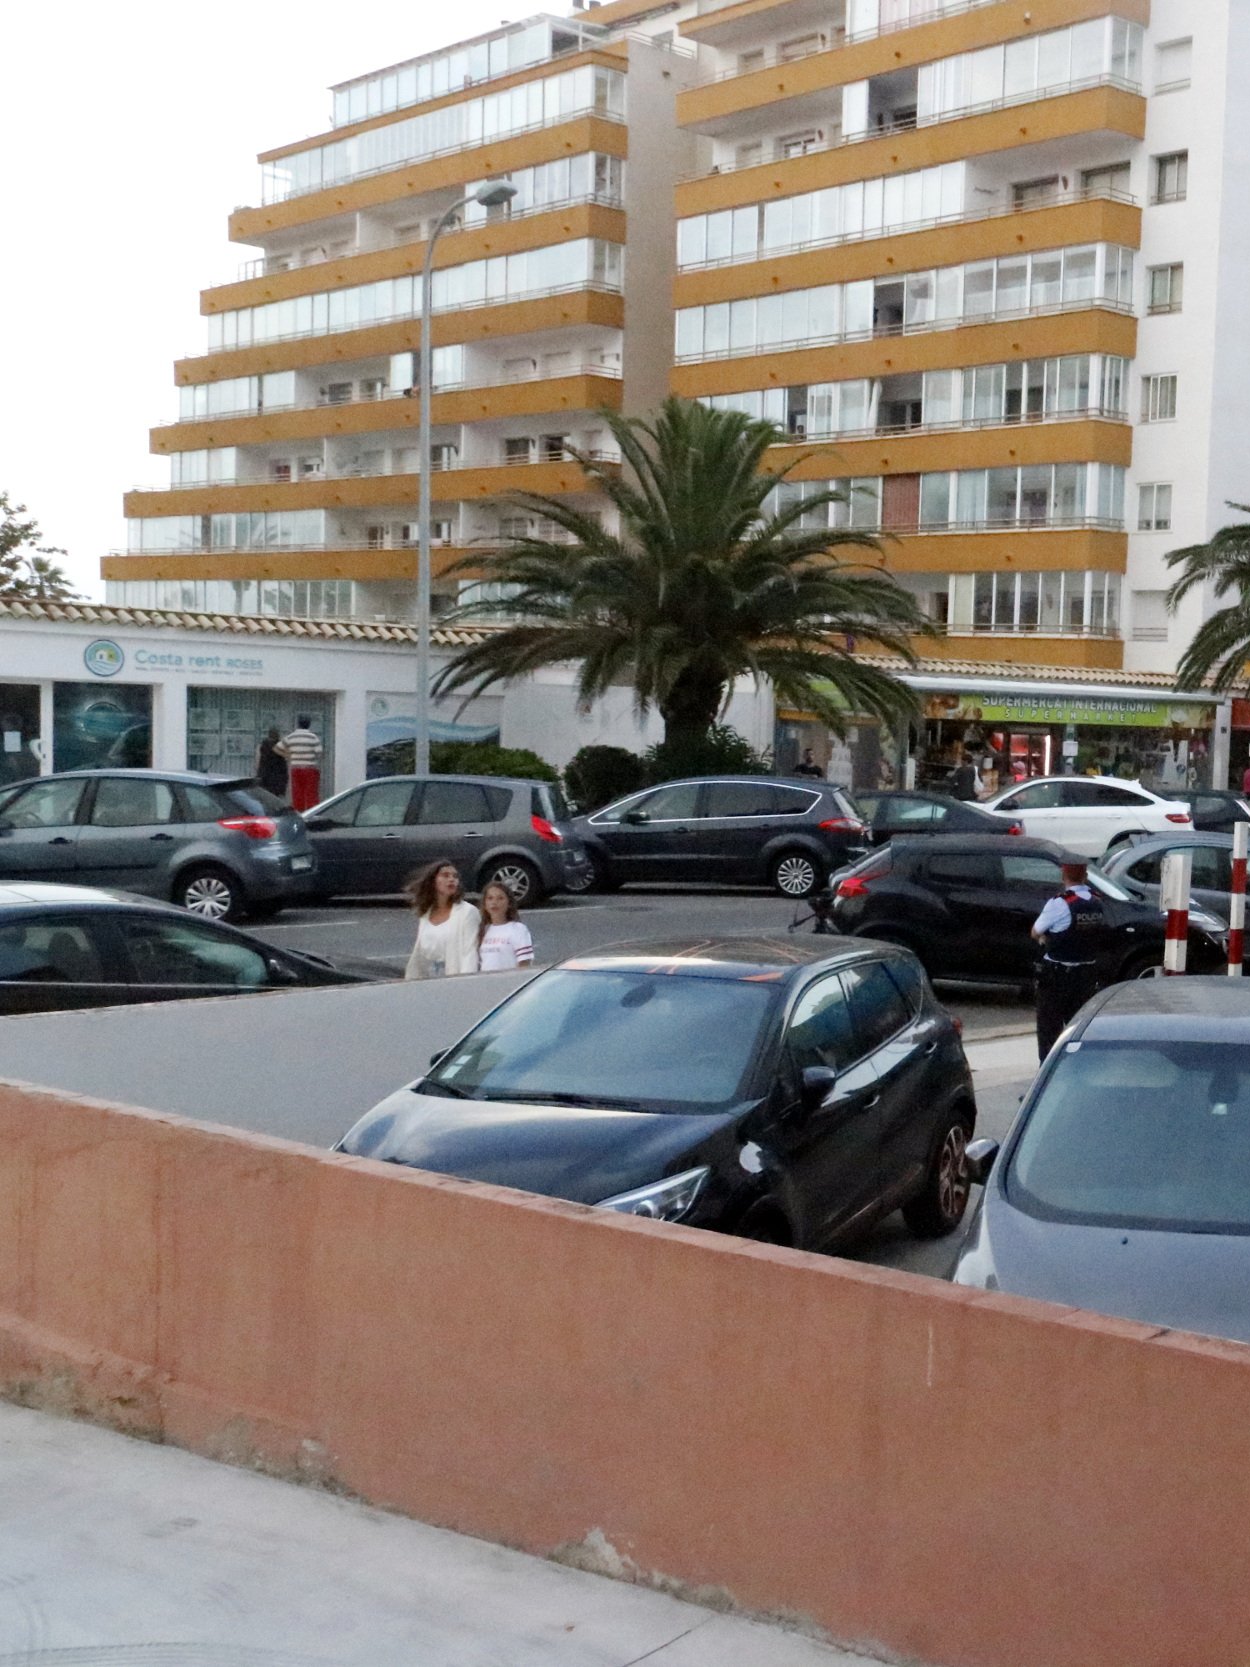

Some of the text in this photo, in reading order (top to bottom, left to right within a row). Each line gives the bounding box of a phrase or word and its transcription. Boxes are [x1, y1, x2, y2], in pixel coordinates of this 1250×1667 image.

[135, 649, 183, 666] Costa
[189, 656, 221, 667] rent
[1071, 698, 1157, 713] INTERNACIONAL
[1005, 709, 1137, 722] SUPERMARKET
